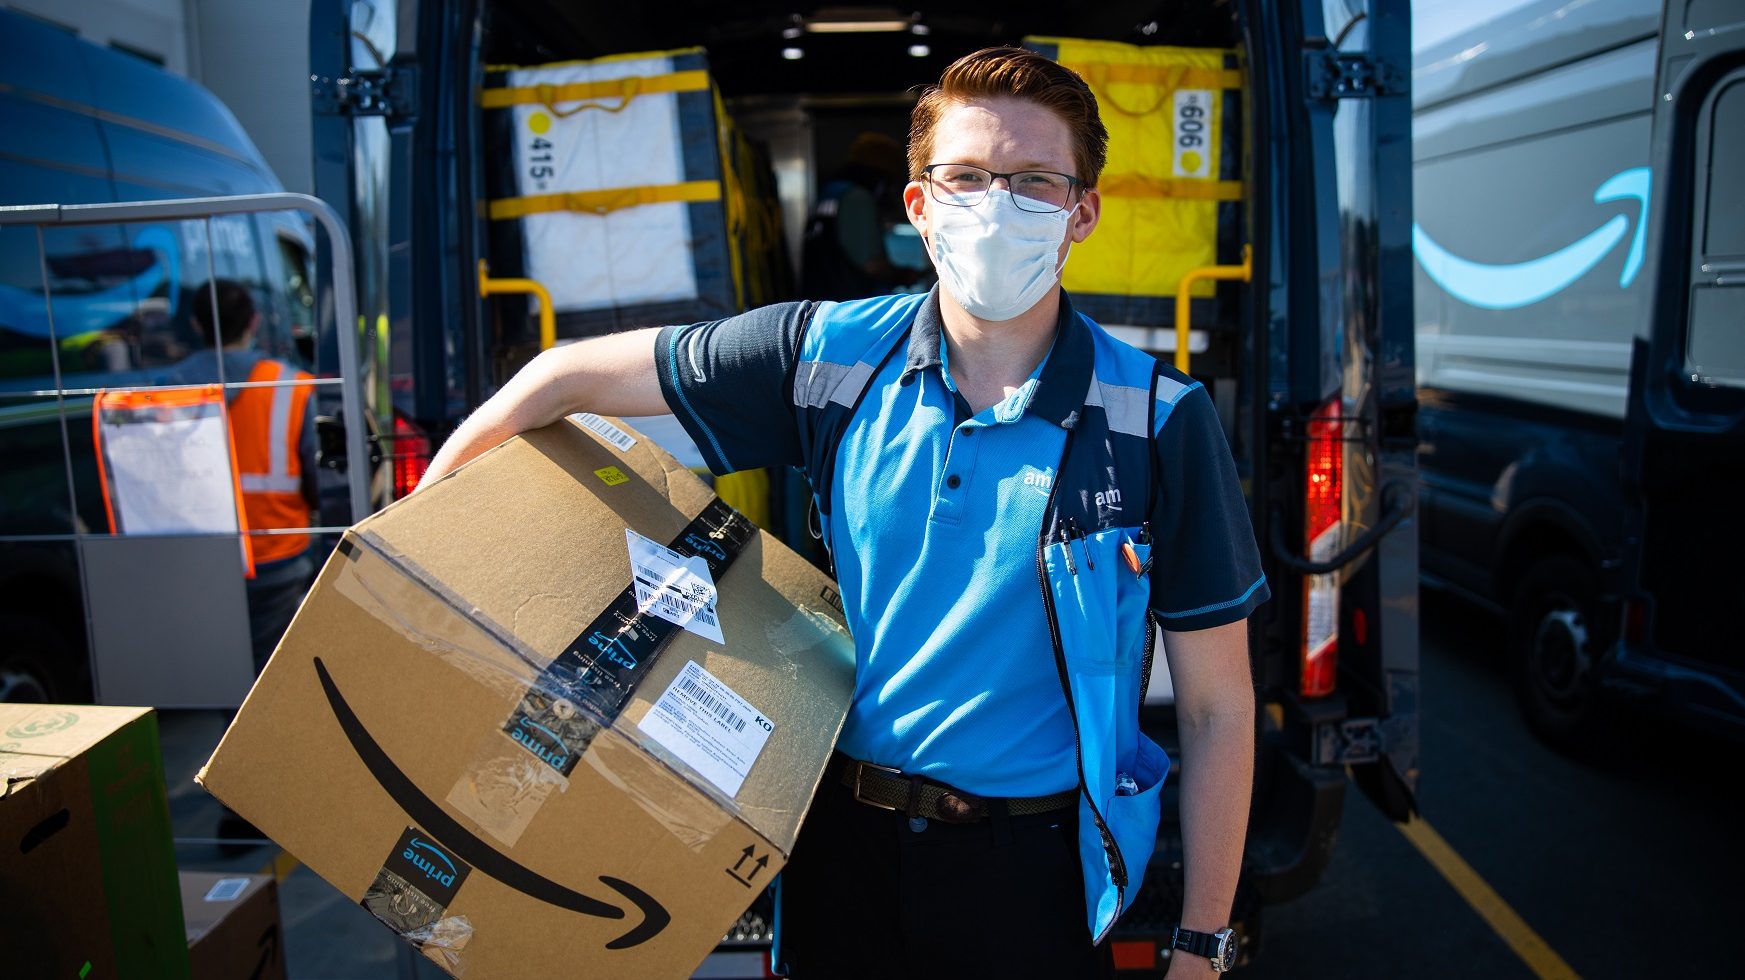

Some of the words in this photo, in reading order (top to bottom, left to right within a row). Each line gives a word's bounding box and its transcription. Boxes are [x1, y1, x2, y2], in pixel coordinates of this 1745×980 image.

[530, 137, 554, 179] 415
[1023, 472, 1052, 489] am
[1095, 488, 1121, 506] am
[572, 650, 605, 677] listning
[588, 636, 637, 670] prime
[672, 686, 697, 706] REMOVE
[713, 717, 732, 733] LABEL
[754, 715, 772, 732] KO
[511, 727, 568, 770] prime
[402, 847, 456, 888] prime
[420, 898, 437, 914] free
